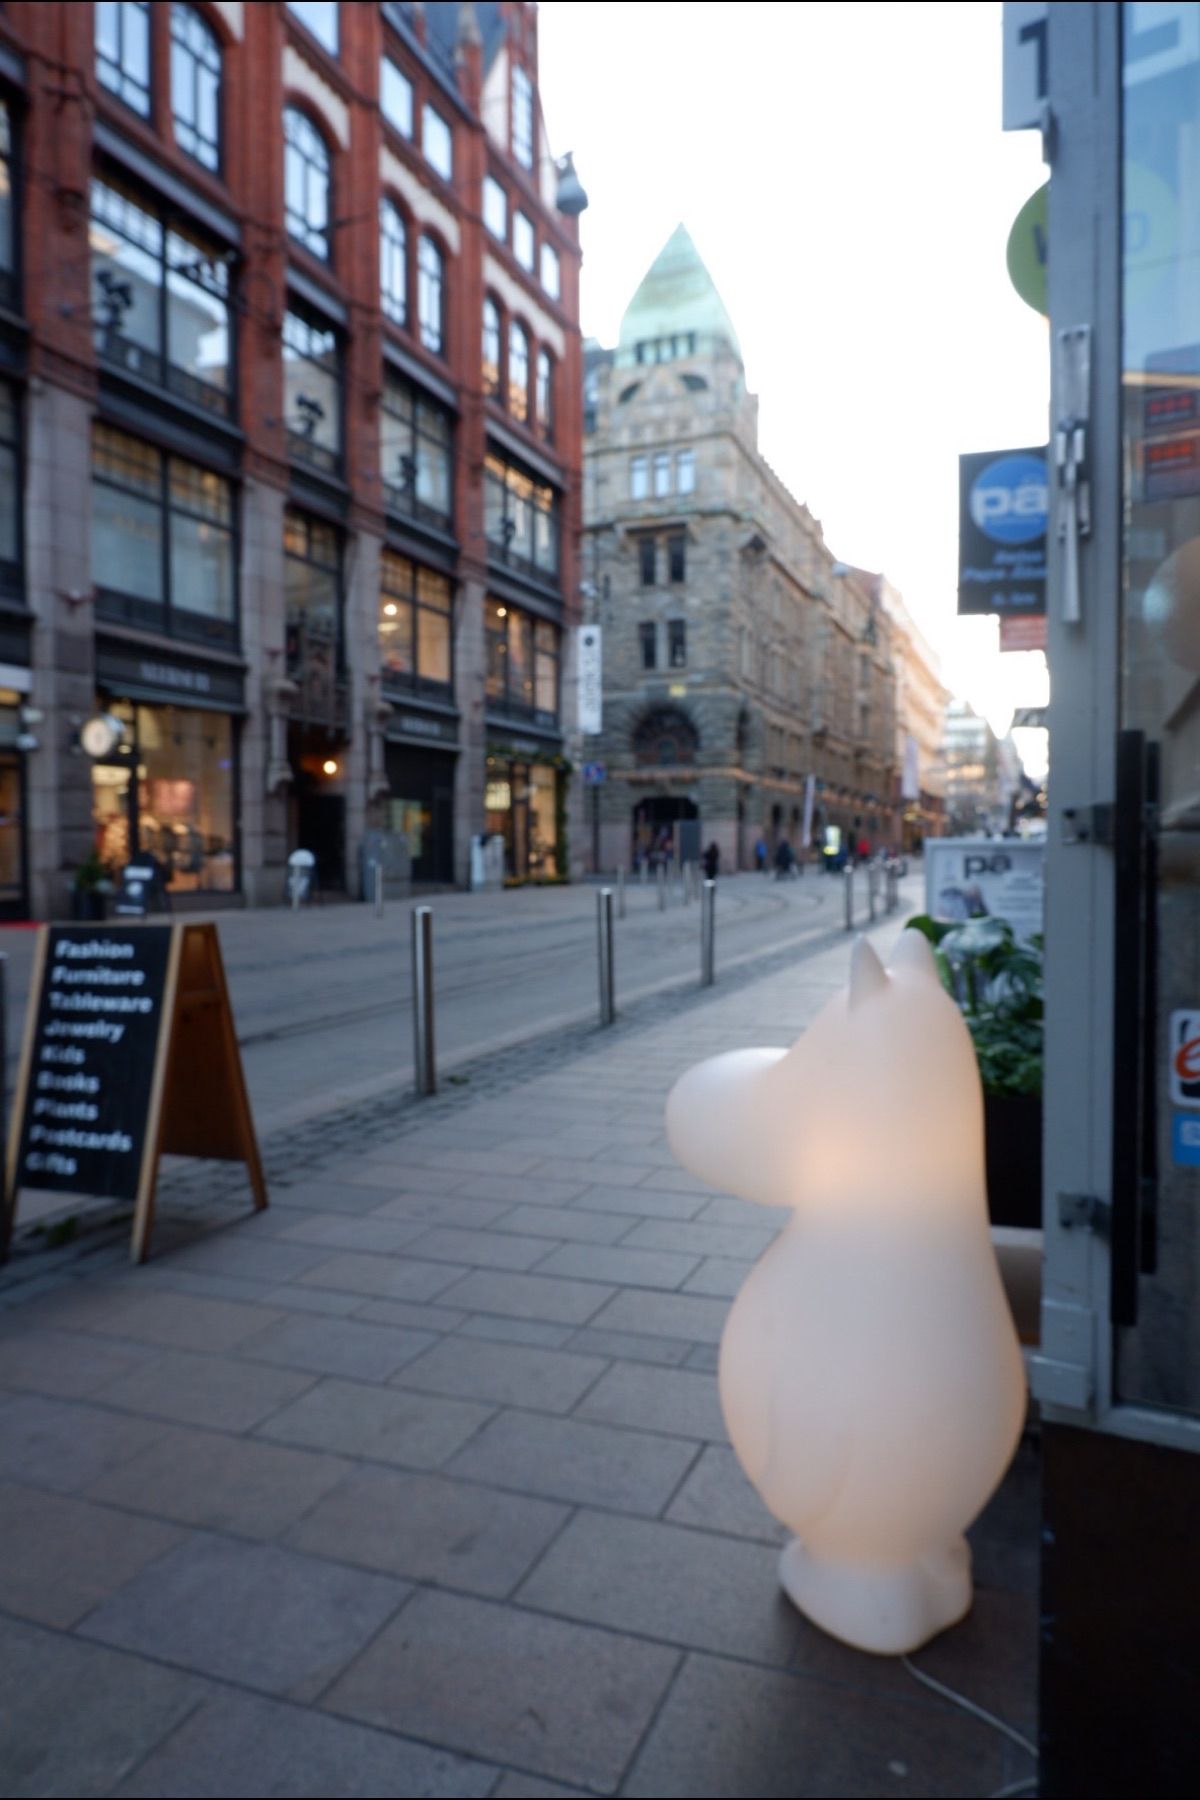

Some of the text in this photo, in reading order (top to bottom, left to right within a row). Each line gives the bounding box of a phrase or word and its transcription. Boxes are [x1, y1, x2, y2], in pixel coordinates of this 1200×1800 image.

[55, 940, 134, 959] Fashion
[52, 965, 145, 986] Furniture
[48, 991, 153, 1014] Tableware
[41, 1044, 86, 1065] Kids
[37, 1070, 100, 1093] Books
[30, 1124, 132, 1152] Postcards
[26, 1152, 78, 1175] Gifts
